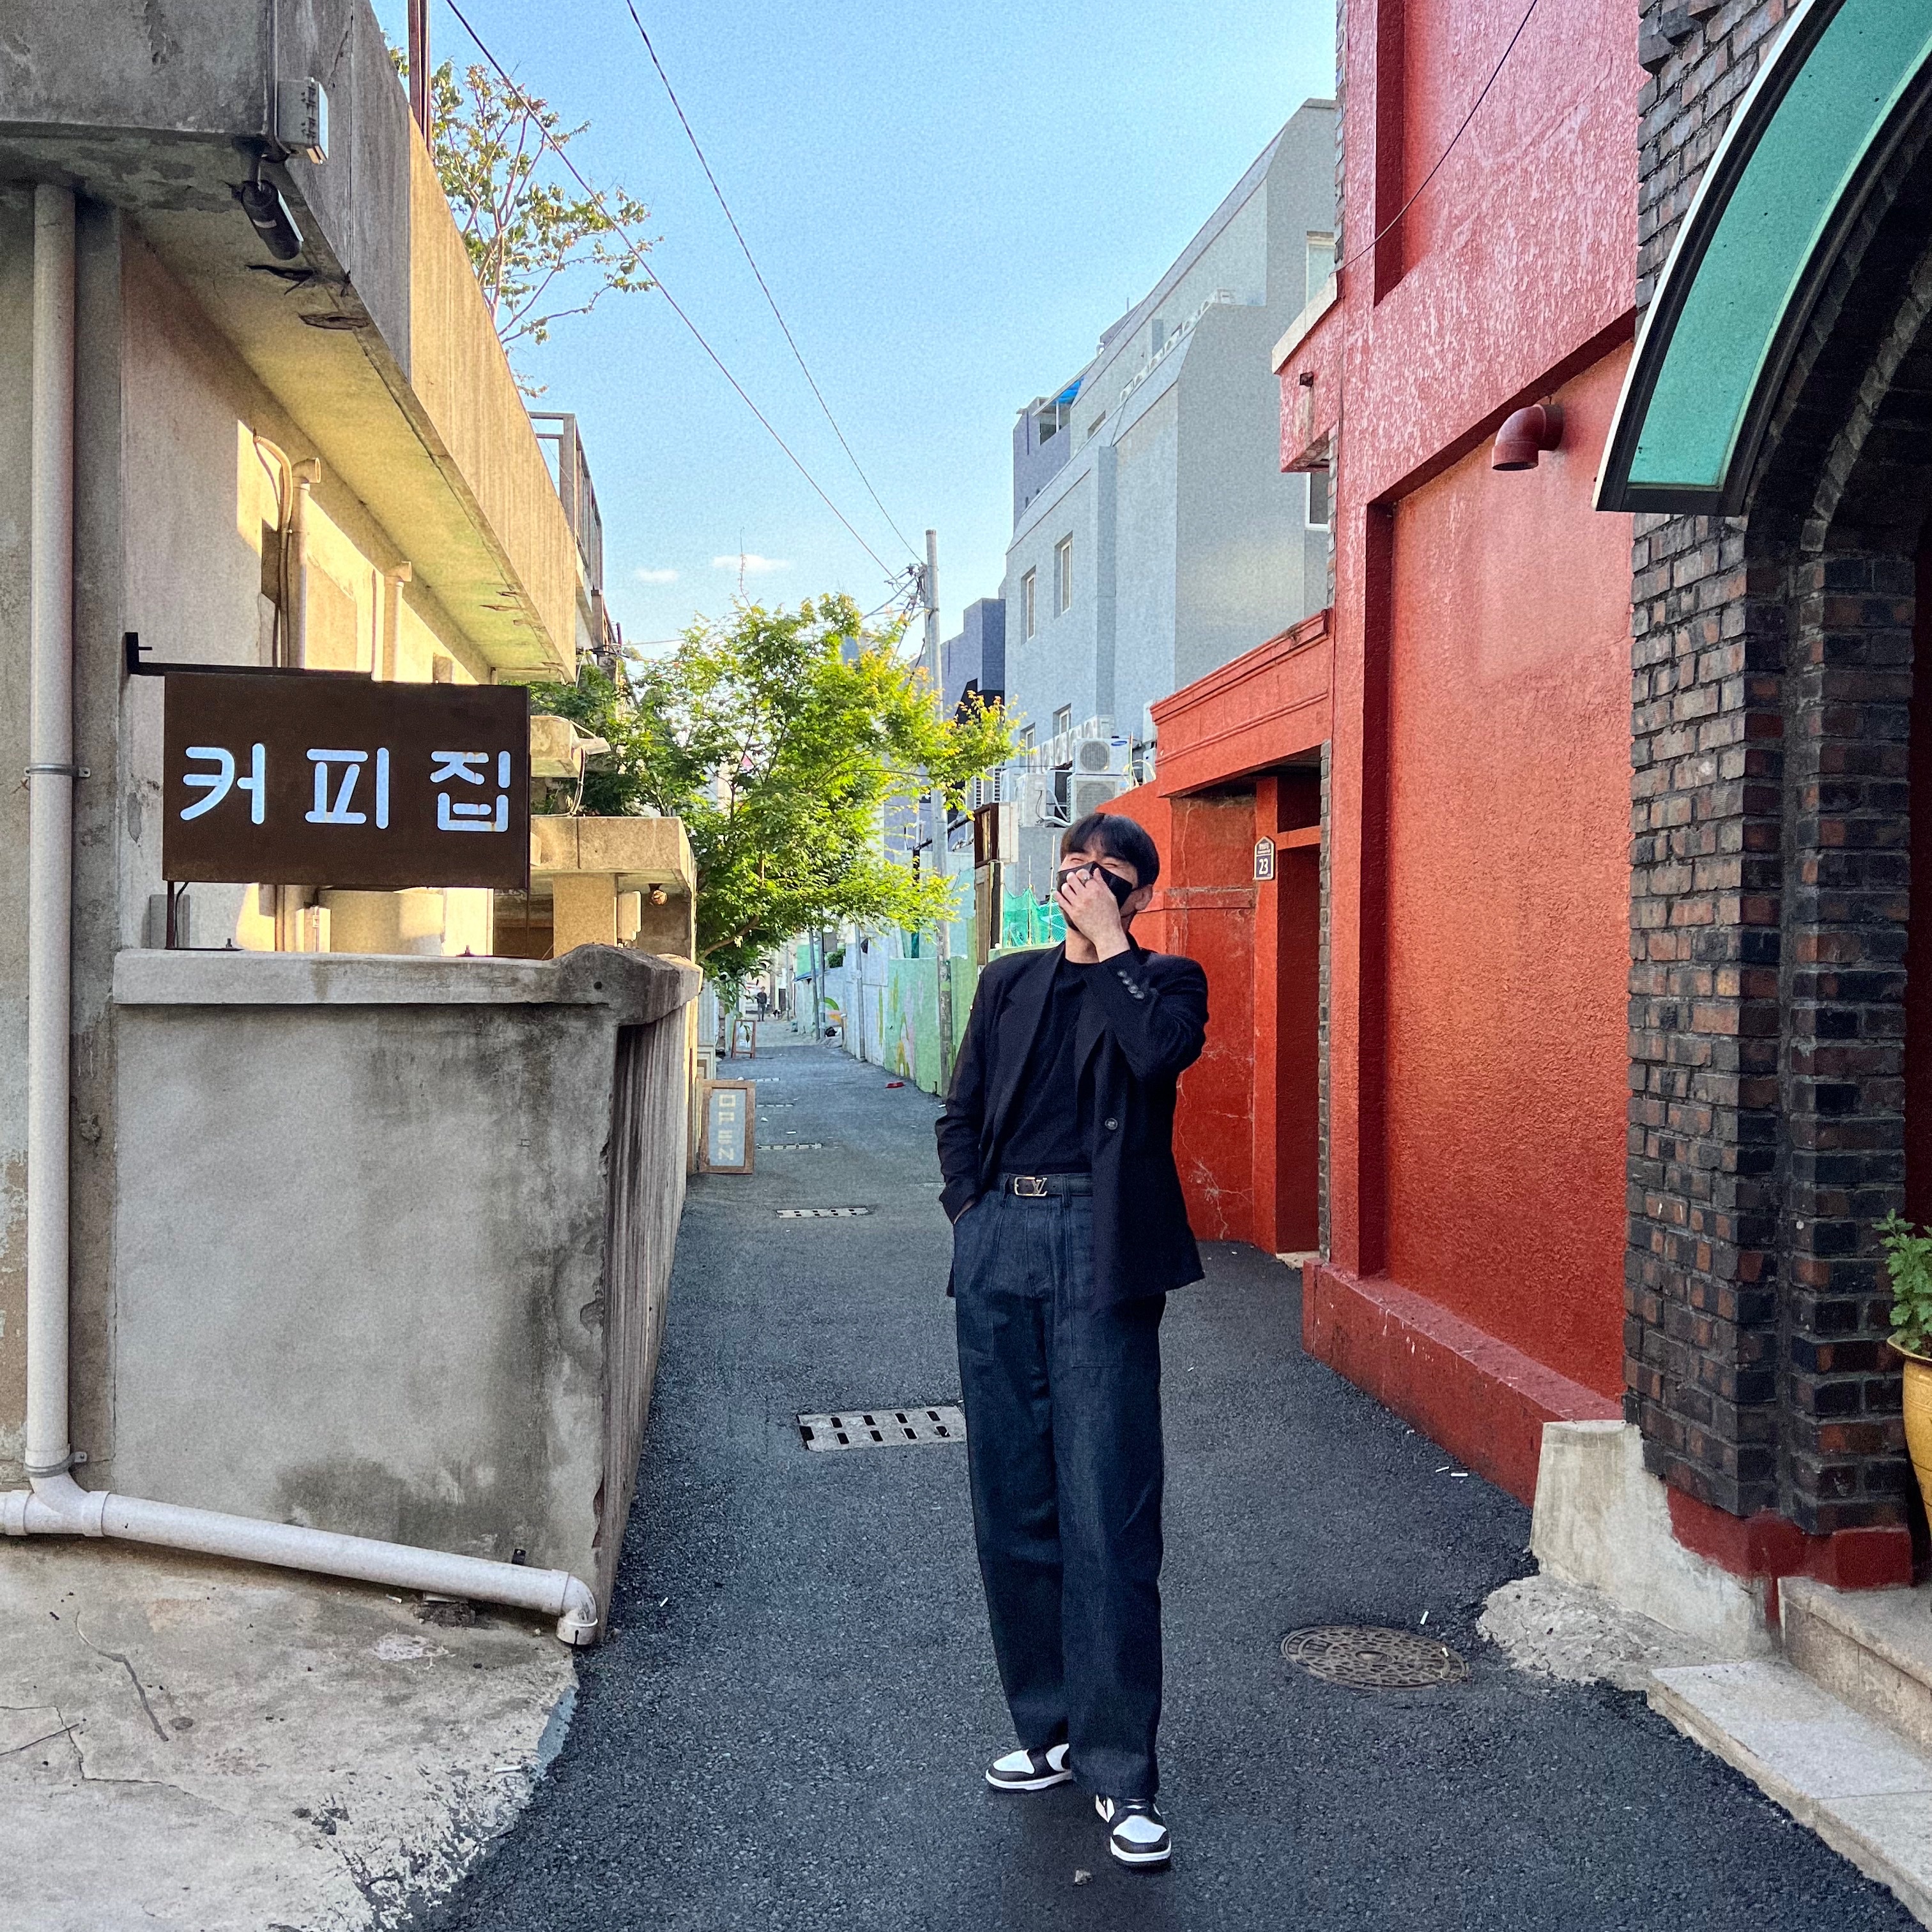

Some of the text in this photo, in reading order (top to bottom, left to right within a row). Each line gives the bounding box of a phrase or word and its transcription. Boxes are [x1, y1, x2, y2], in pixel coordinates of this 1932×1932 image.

[180, 742, 512, 832] 커피집
[1259, 857, 1269, 875] 23
[718, 1094, 736, 1161] OPEN
